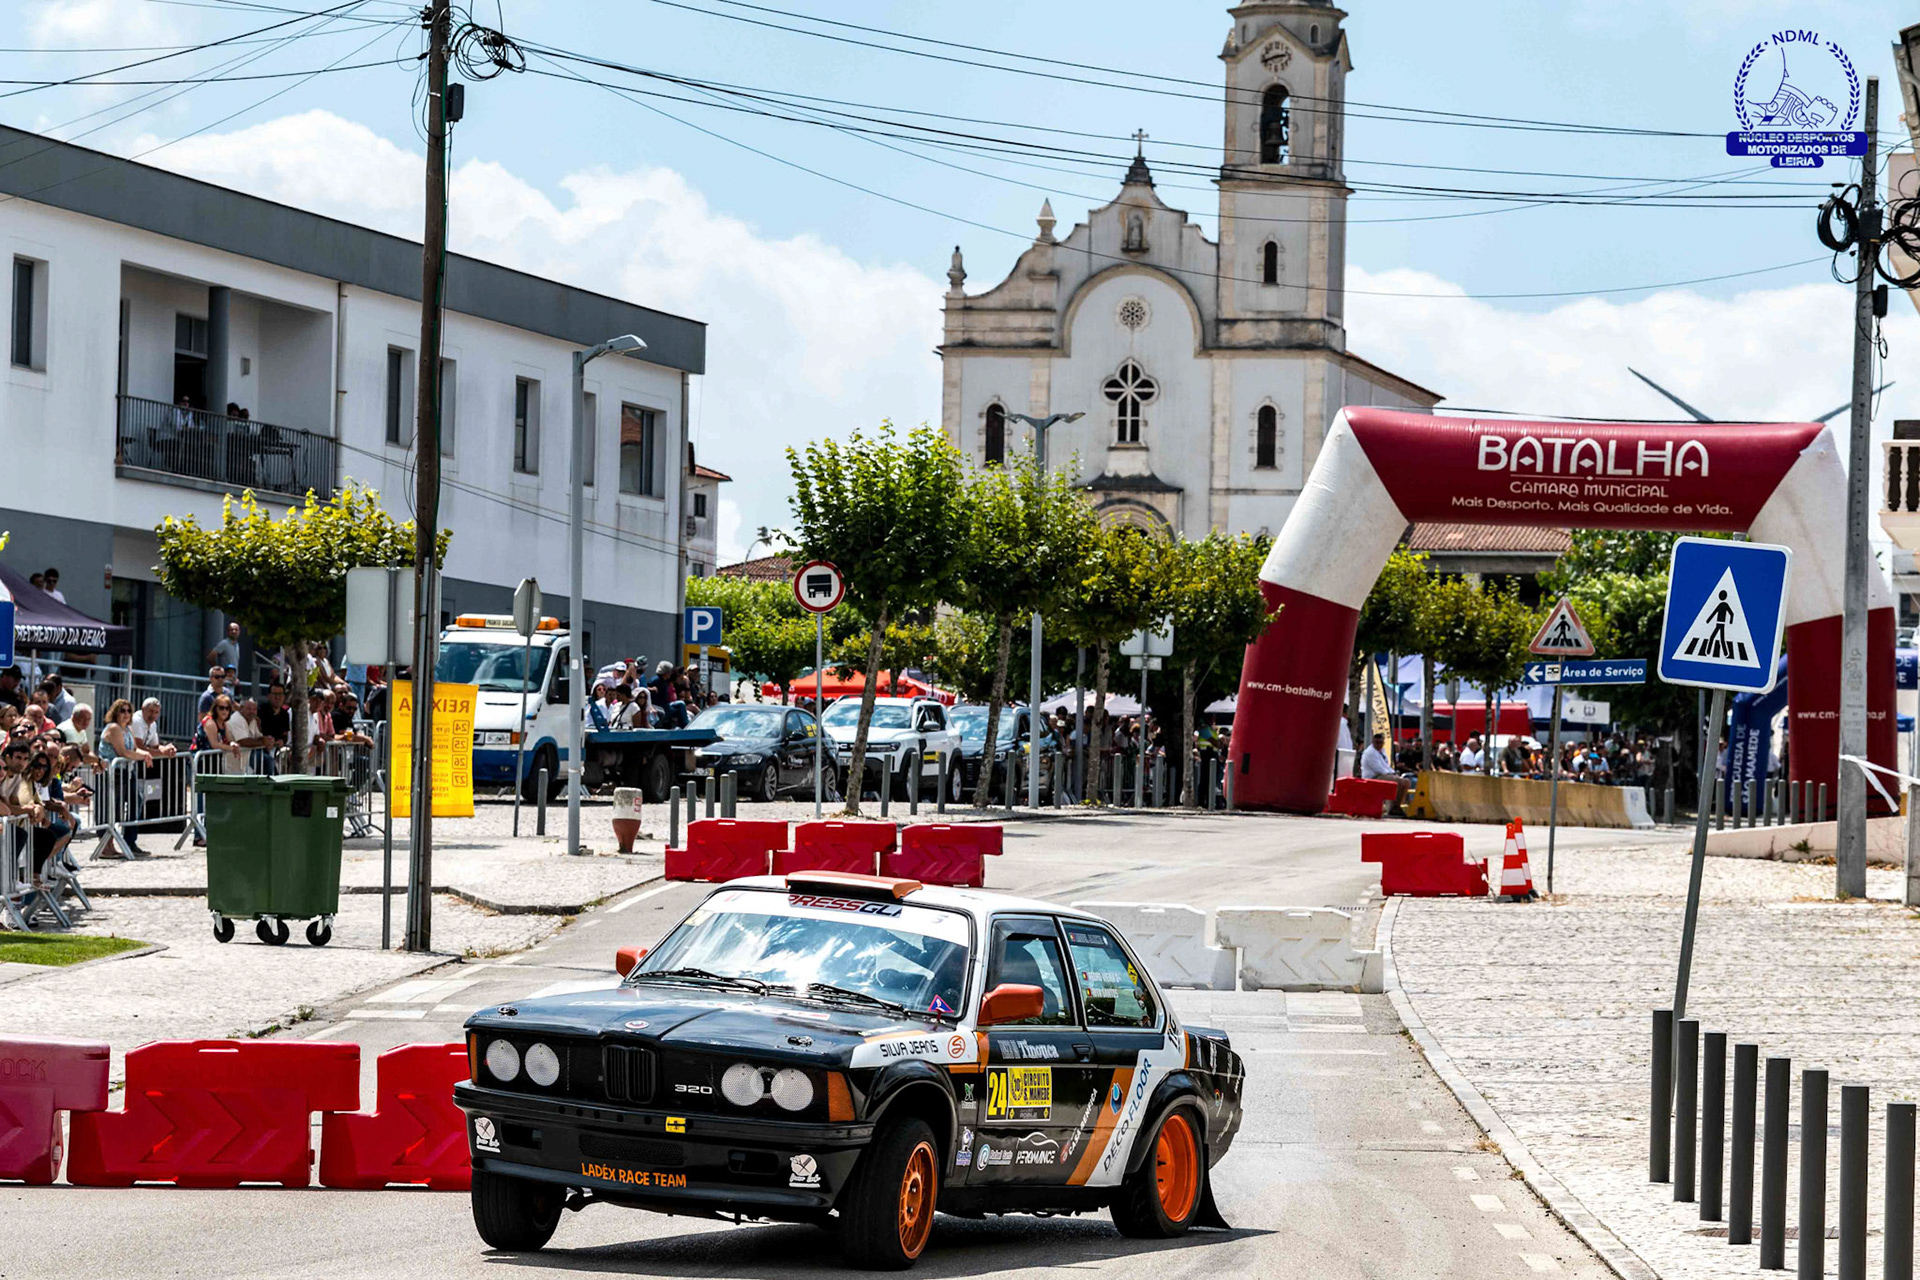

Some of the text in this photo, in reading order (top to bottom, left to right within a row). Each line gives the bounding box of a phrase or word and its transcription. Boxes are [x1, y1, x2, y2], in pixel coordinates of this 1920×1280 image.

[1477, 435, 1709, 477] BATALHA
[1451, 496, 1733, 515] Mais Desporto. Mais Qualidade de Vida.
[67, 628, 79, 646] DA
[691, 610, 714, 642] P
[1562, 666, 1644, 678] Área de Serviço
[1246, 681, 1333, 701] www.cm-batalha.pt
[1747, 728, 1760, 780] MAMEDE
[880, 1042, 907, 1057] SILVA
[908, 1039, 939, 1056] JEANS
[674, 1084, 713, 1095] 320
[988, 1072, 1007, 1116] 24
[1023, 1073, 1050, 1086] CIRCUITO
[1103, 1119, 1131, 1172] DECO
[1128, 1057, 1152, 1122] FLOOR
[581, 1162, 687, 1188] LADÉX RACE TEAM
